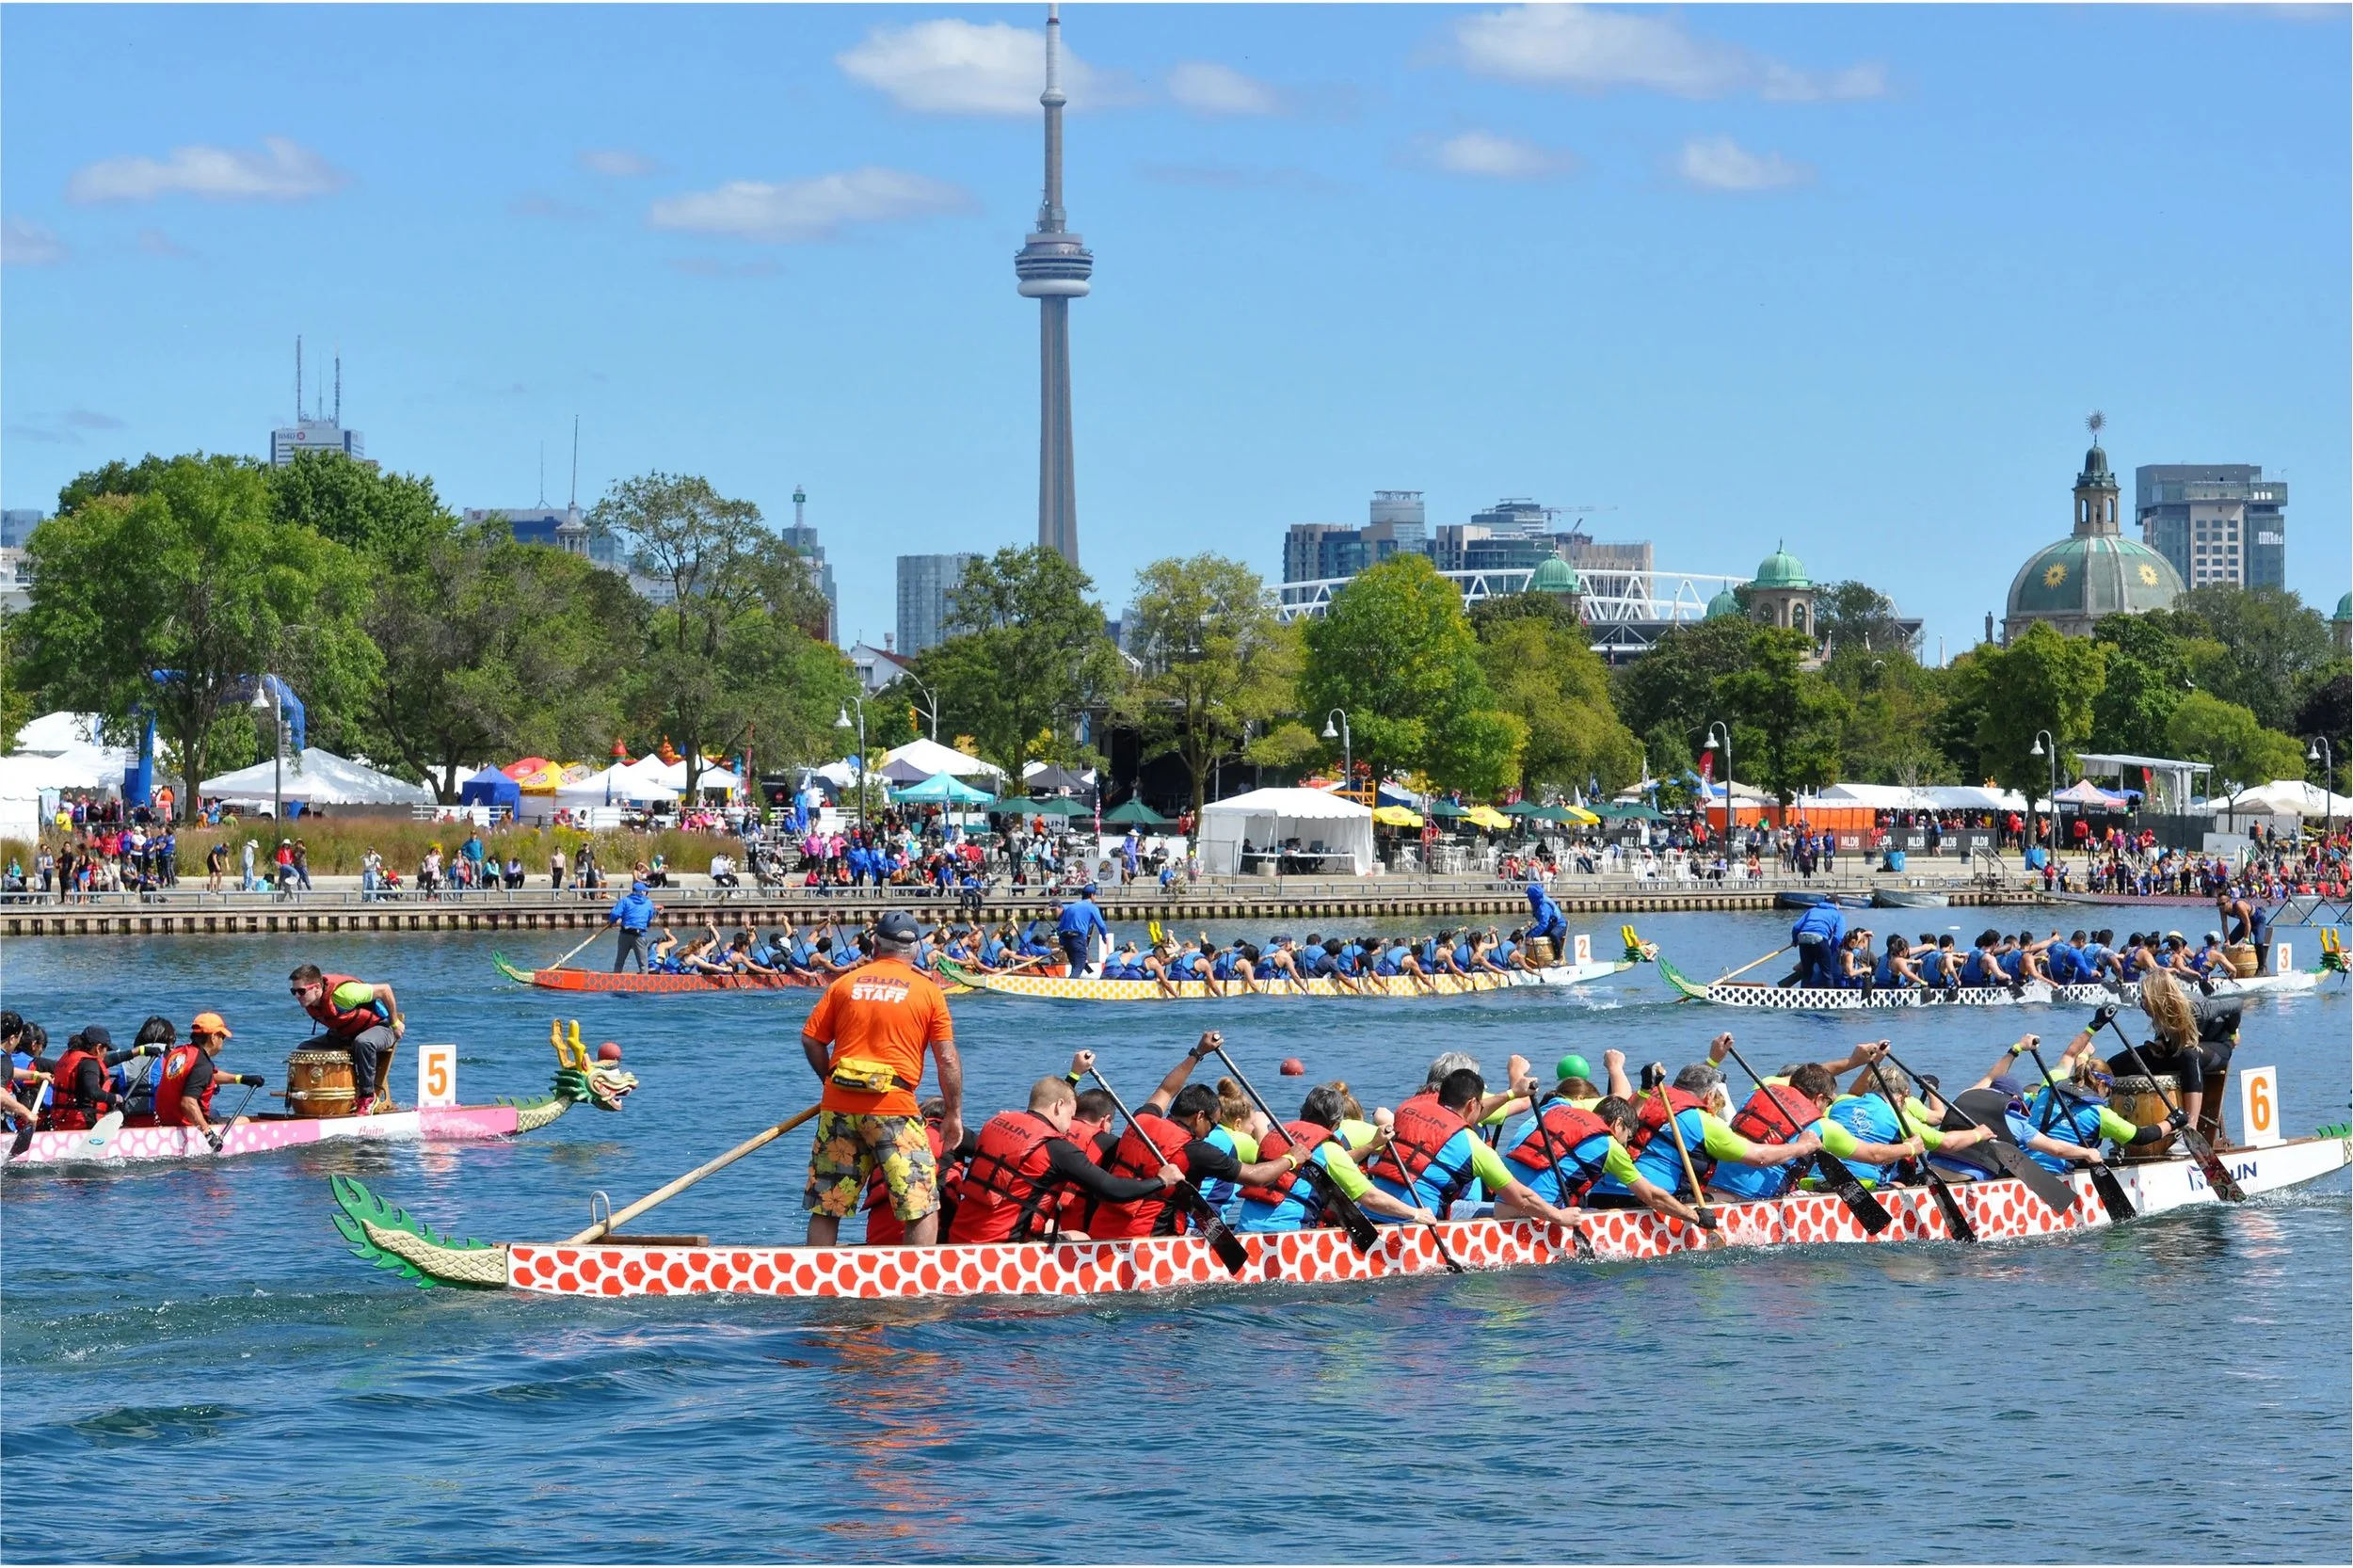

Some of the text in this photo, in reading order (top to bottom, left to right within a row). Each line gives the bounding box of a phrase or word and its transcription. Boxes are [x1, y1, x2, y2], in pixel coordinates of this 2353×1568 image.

[1841, 836, 1860, 846] MLDB
[1907, 836, 1925, 846] MLDB
[1940, 836, 1957, 846] MLDB
[1972, 836, 1989, 846] MLDB
[1578, 938, 1587, 958] 2
[2281, 947, 2288, 968] 3
[856, 975, 911, 988] GWN
[851, 987, 908, 1004] STAFF
[427, 1053, 447, 1096] 5
[2249, 1076, 2270, 1131] 6
[1402, 1107, 1449, 1129] GWN
[991, 1117, 1032, 1140] GWN
